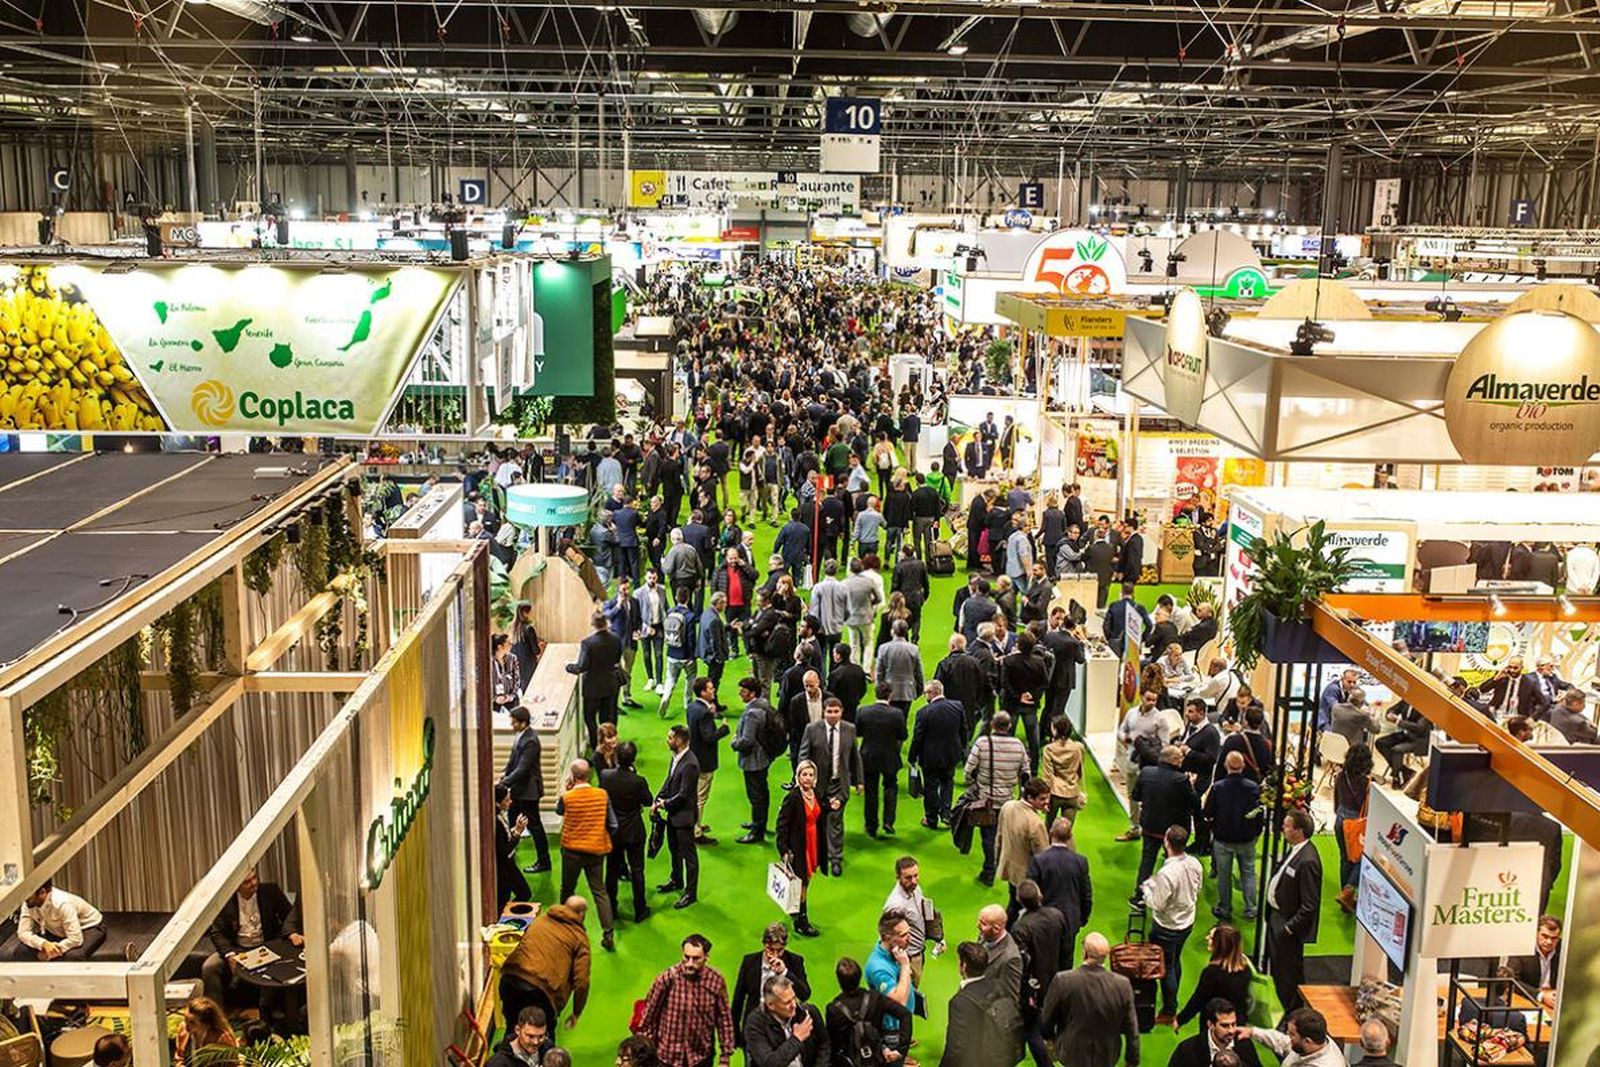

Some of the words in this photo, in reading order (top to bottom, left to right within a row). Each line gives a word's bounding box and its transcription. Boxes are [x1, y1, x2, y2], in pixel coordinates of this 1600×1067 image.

[845, 105, 875, 130] 10
[54, 170, 69, 190] C
[783, 173, 795, 183] 10
[464, 183, 481, 202] D
[1025, 187, 1037, 205] E
[1516, 203, 1528, 221] F
[1466, 374, 1600, 401] Almaverde
[239, 391, 355, 427] Coplaca
[1516, 400, 1548, 419] bio
[1489, 422, 1523, 433] organic
[1524, 421, 1574, 432] production
[1463, 886, 1522, 908] Fruit
[1431, 904, 1533, 926] Masters.
